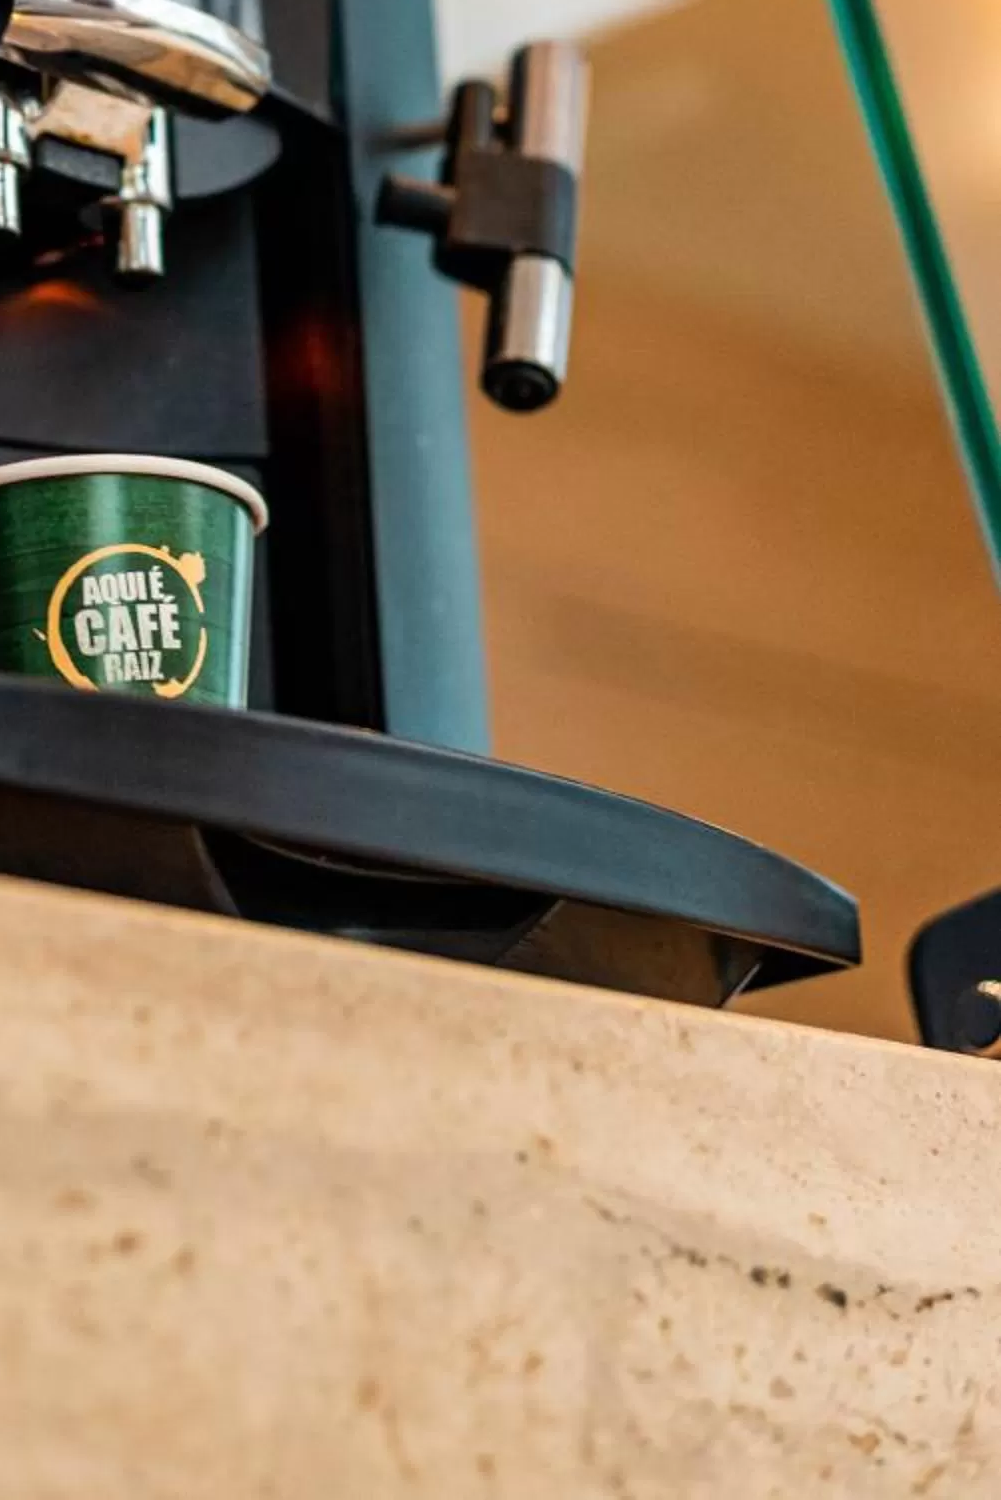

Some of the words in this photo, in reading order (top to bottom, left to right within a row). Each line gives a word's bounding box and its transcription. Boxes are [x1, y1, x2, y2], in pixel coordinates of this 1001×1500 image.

[82, 570, 148, 606] AQUI
[148, 565, 166, 601] É
[74, 595, 182, 657] CAFÉ
[103, 650, 165, 683] RAIZ
